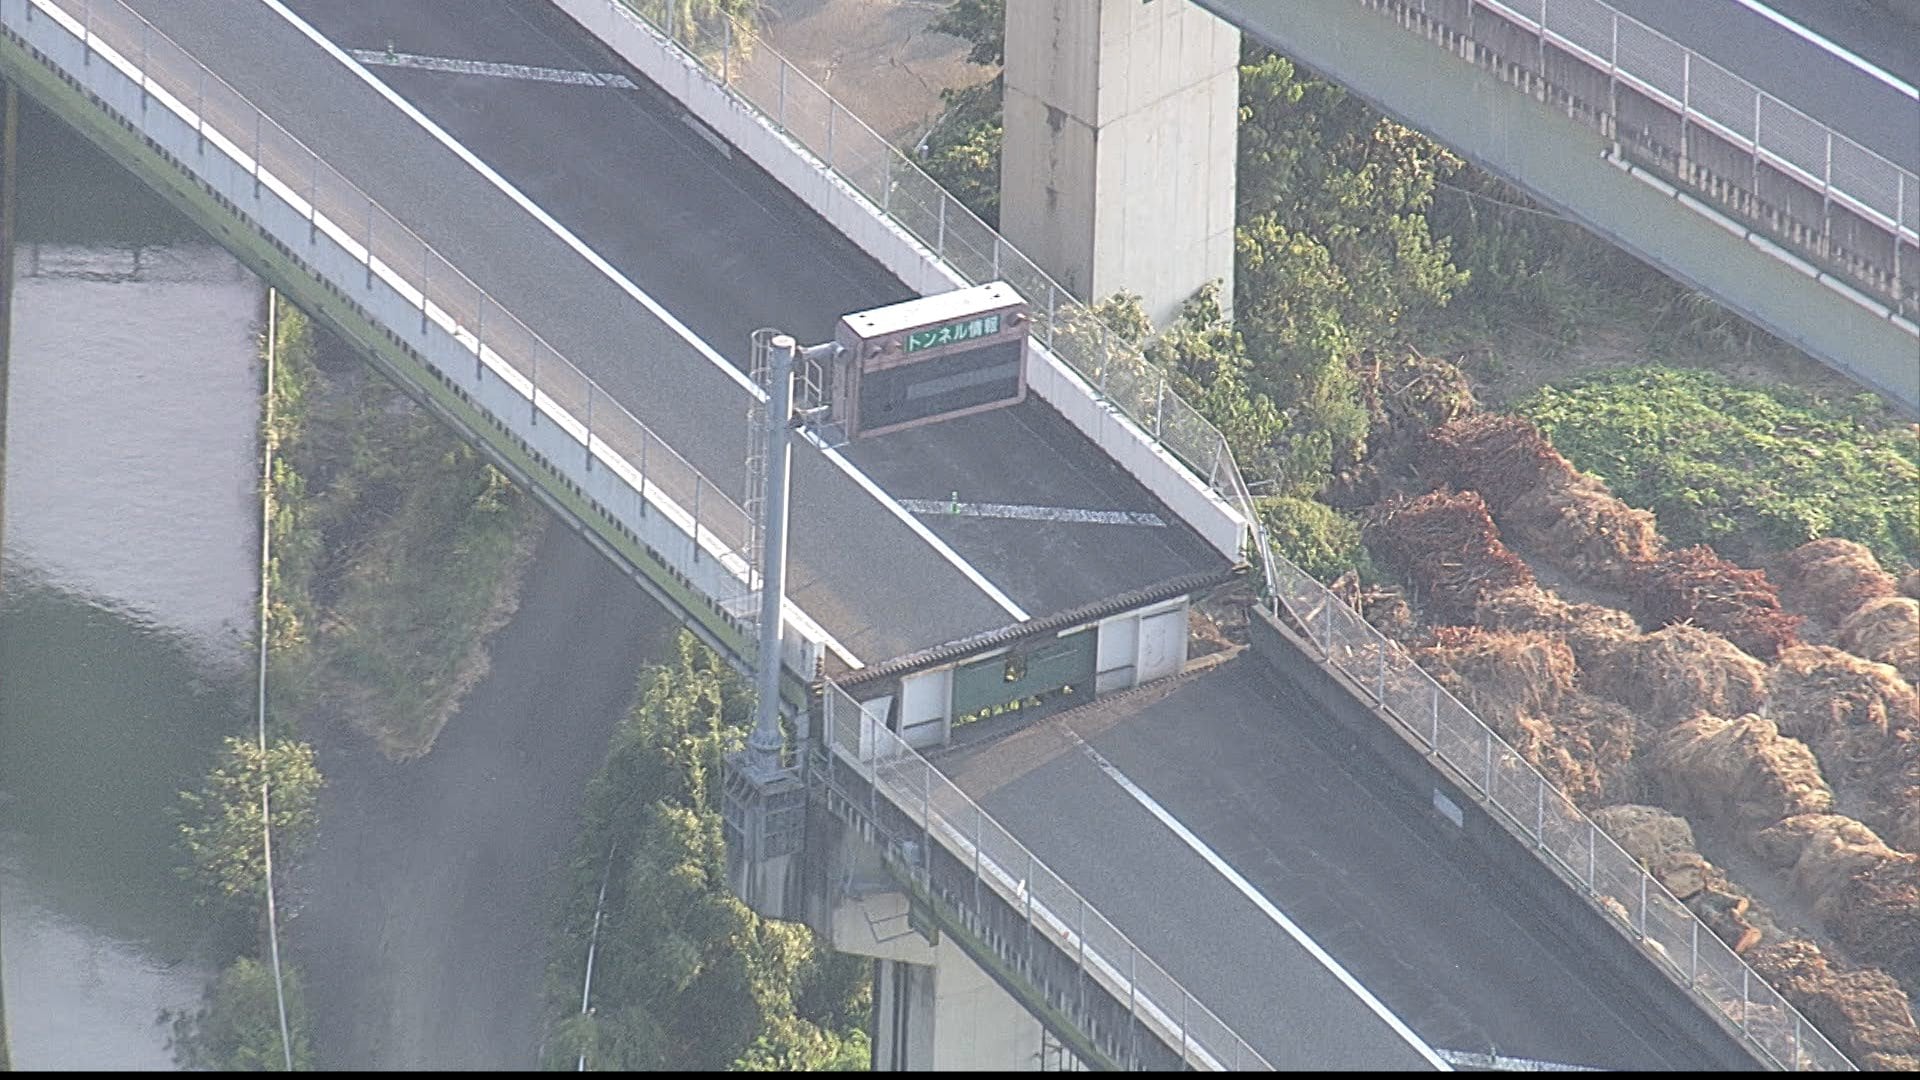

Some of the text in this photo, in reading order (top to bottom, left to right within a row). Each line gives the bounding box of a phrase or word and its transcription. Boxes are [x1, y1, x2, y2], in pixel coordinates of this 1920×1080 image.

[909, 316, 998, 350] トンネル情報
